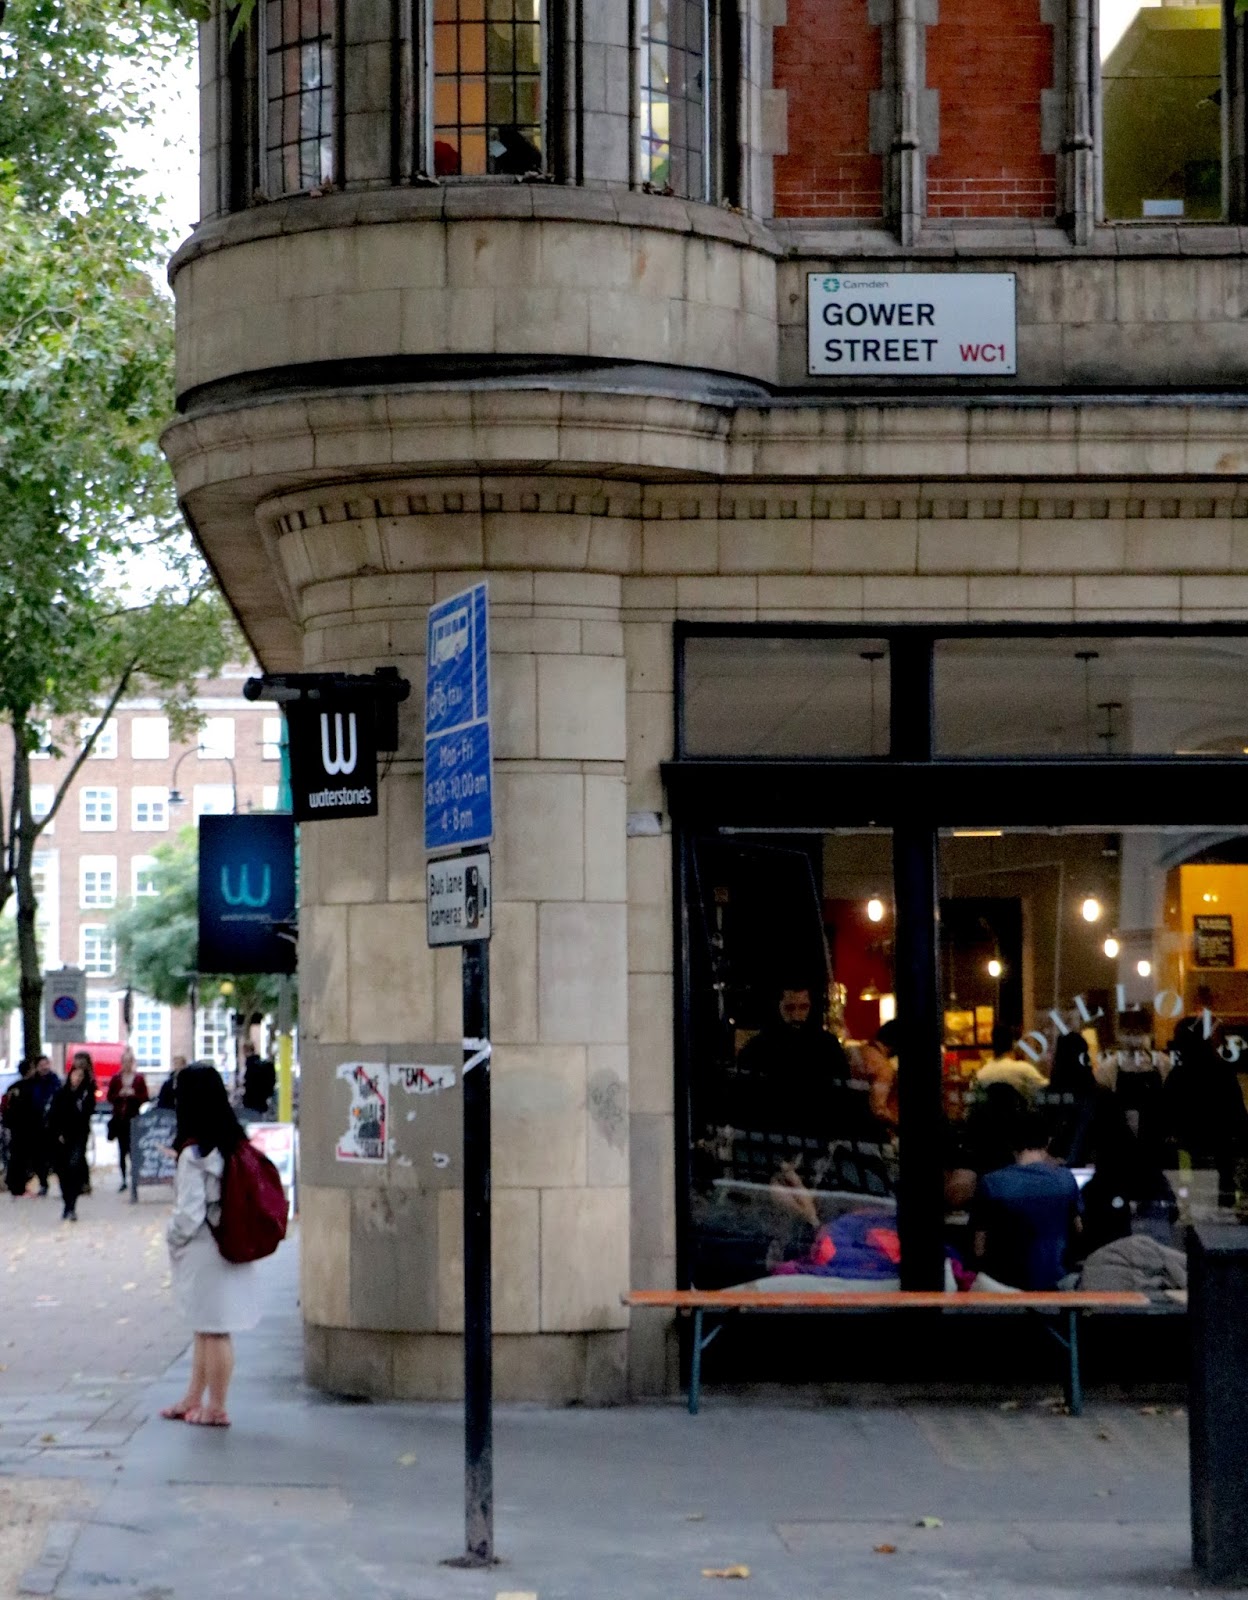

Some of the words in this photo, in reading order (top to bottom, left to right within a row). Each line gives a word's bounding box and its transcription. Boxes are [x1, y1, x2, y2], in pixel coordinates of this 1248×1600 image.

[843, 279, 889, 289] Camden
[822, 303, 935, 326] GOWER
[824, 339, 938, 362] STREET
[959, 344, 1005, 362] WC1
[430, 874, 444, 896] Bus
[445, 872, 462, 893] lane
[431, 906, 462, 927] cameras
